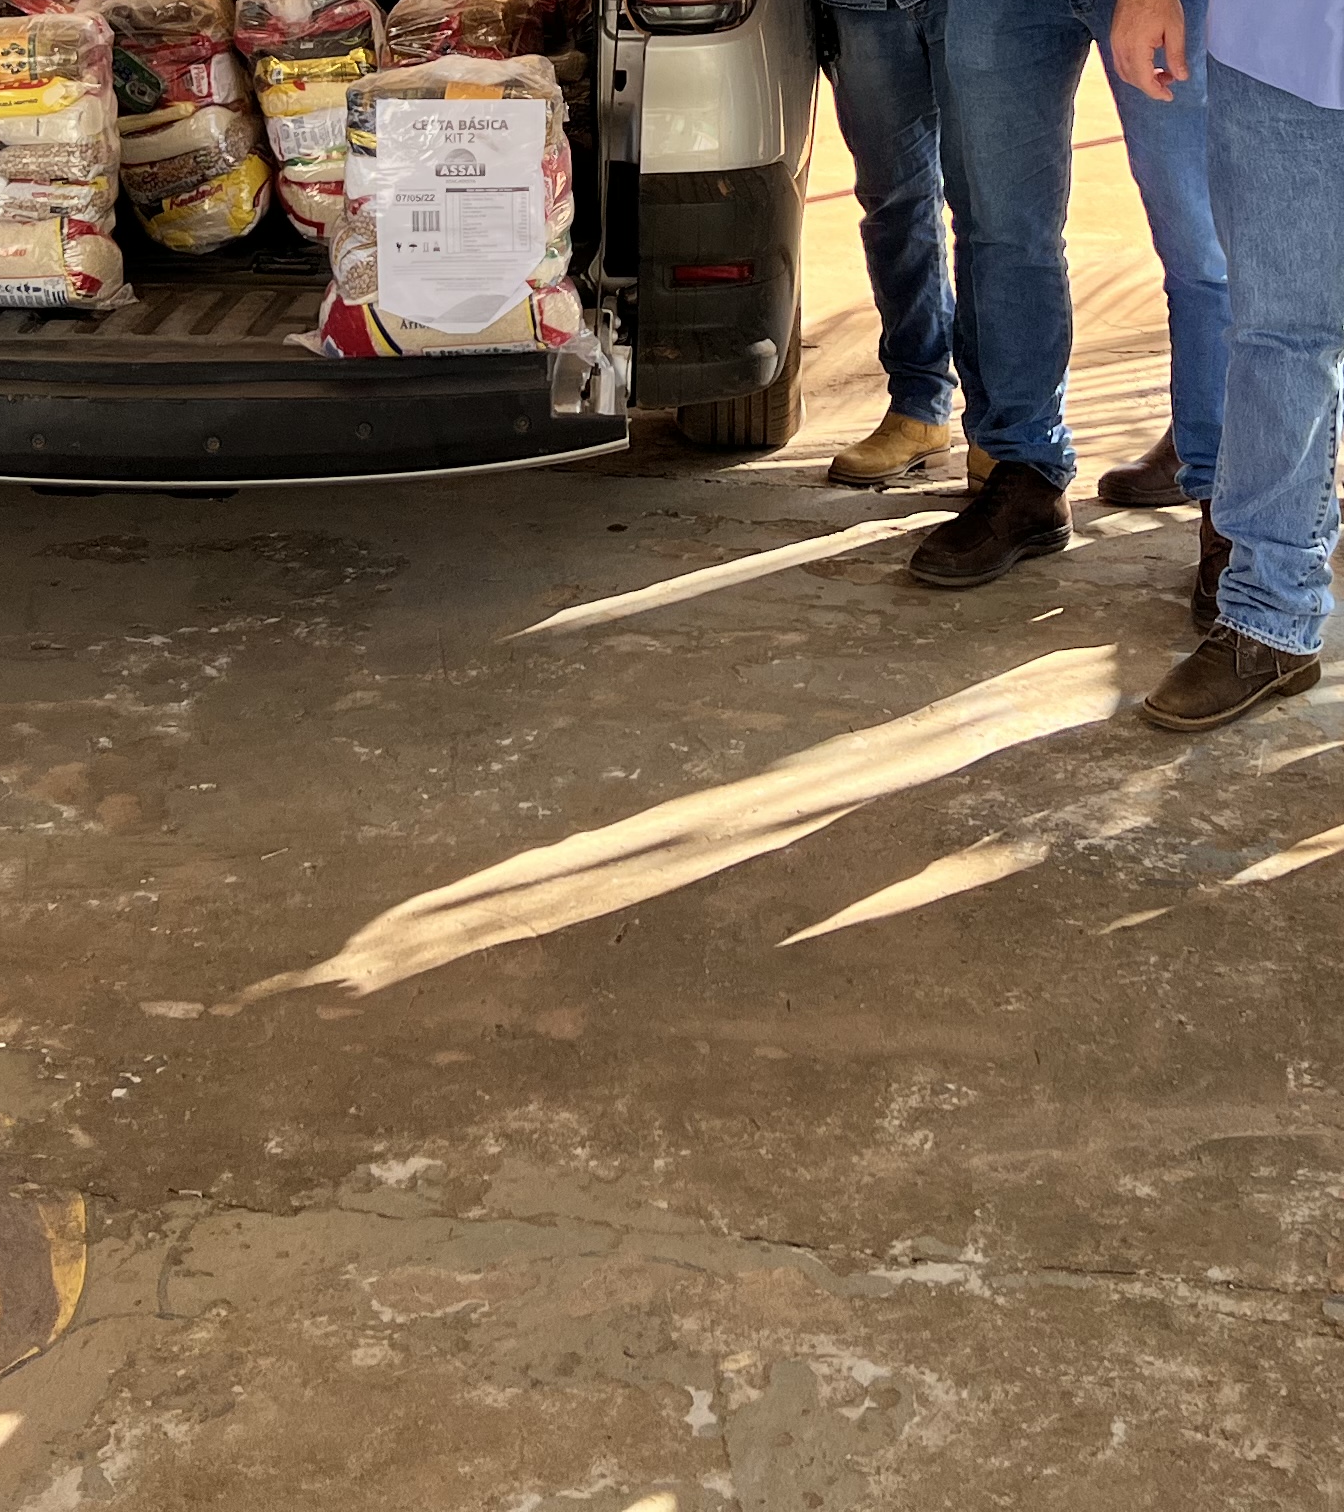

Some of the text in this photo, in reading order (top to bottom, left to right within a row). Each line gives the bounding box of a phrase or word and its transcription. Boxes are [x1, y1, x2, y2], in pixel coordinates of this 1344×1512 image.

[458, 116, 509, 131] BÁSICA
[444, 133, 476, 143] KIT 2
[395, 193, 436, 202] 07/05/22
